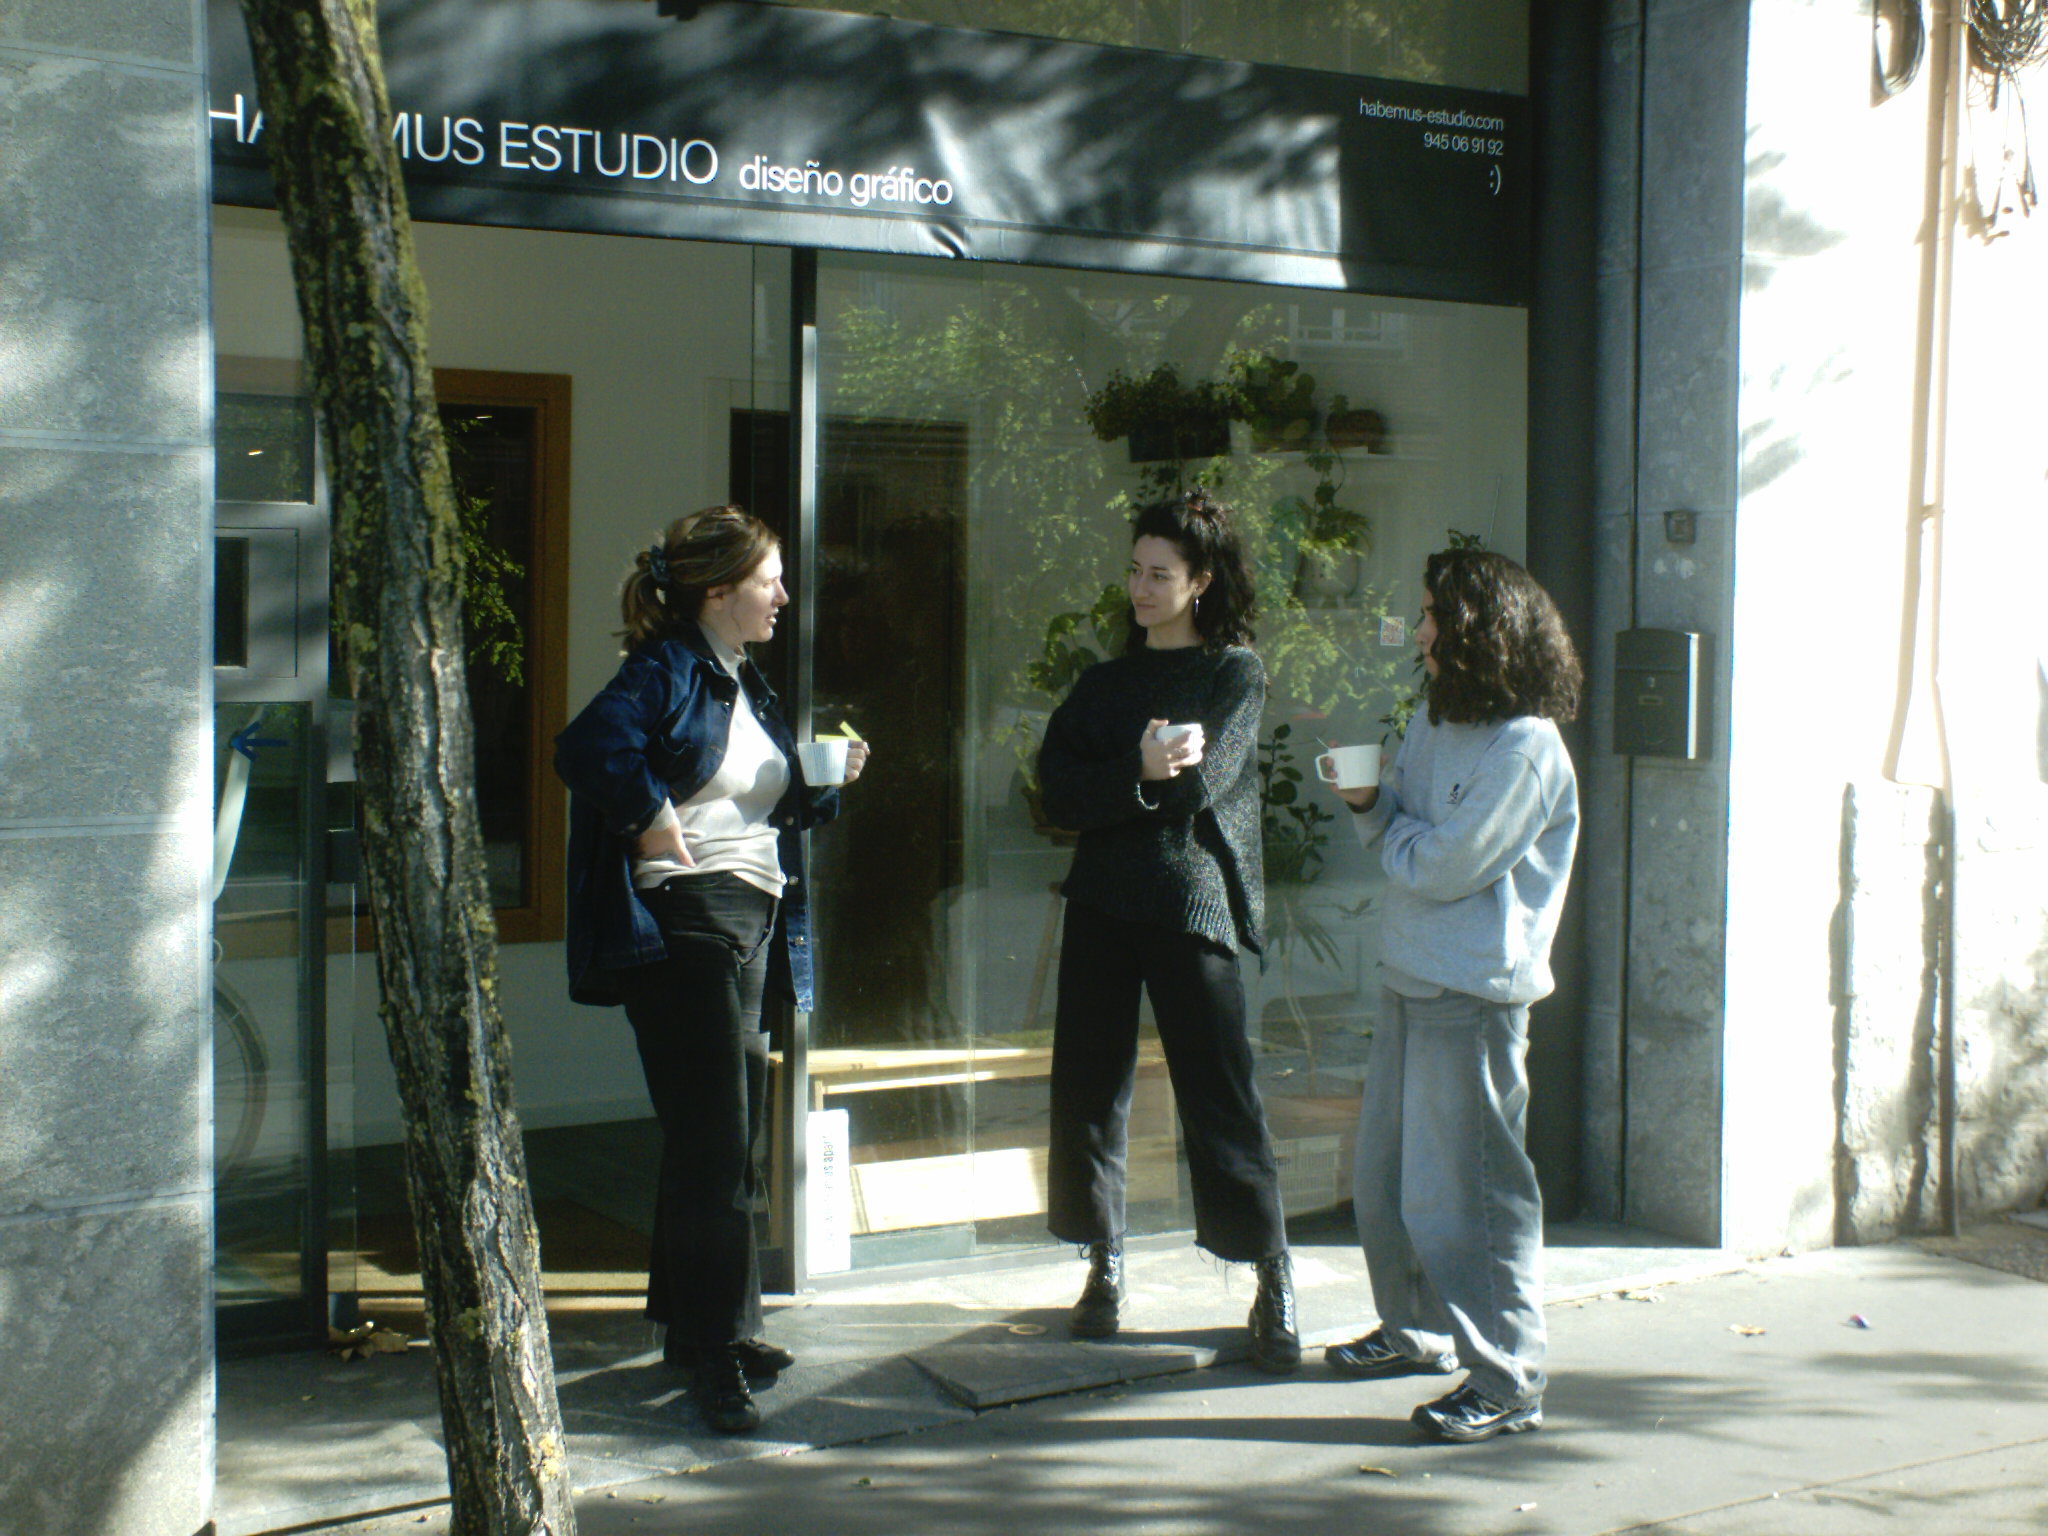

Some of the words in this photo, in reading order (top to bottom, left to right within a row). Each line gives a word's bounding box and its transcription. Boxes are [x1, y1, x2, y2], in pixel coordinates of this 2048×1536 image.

[1359, 97, 1504, 131] habemus-estudio.com
[1424, 131, 1449, 150] 945
[1451, 134, 1469, 152] 06
[1471, 137, 1485, 154] 91
[1487, 139, 1504, 156] 92
[499, 121, 719, 185] ESTUDIO
[739, 155, 843, 197] diseño
[849, 165, 953, 208] gráfico
